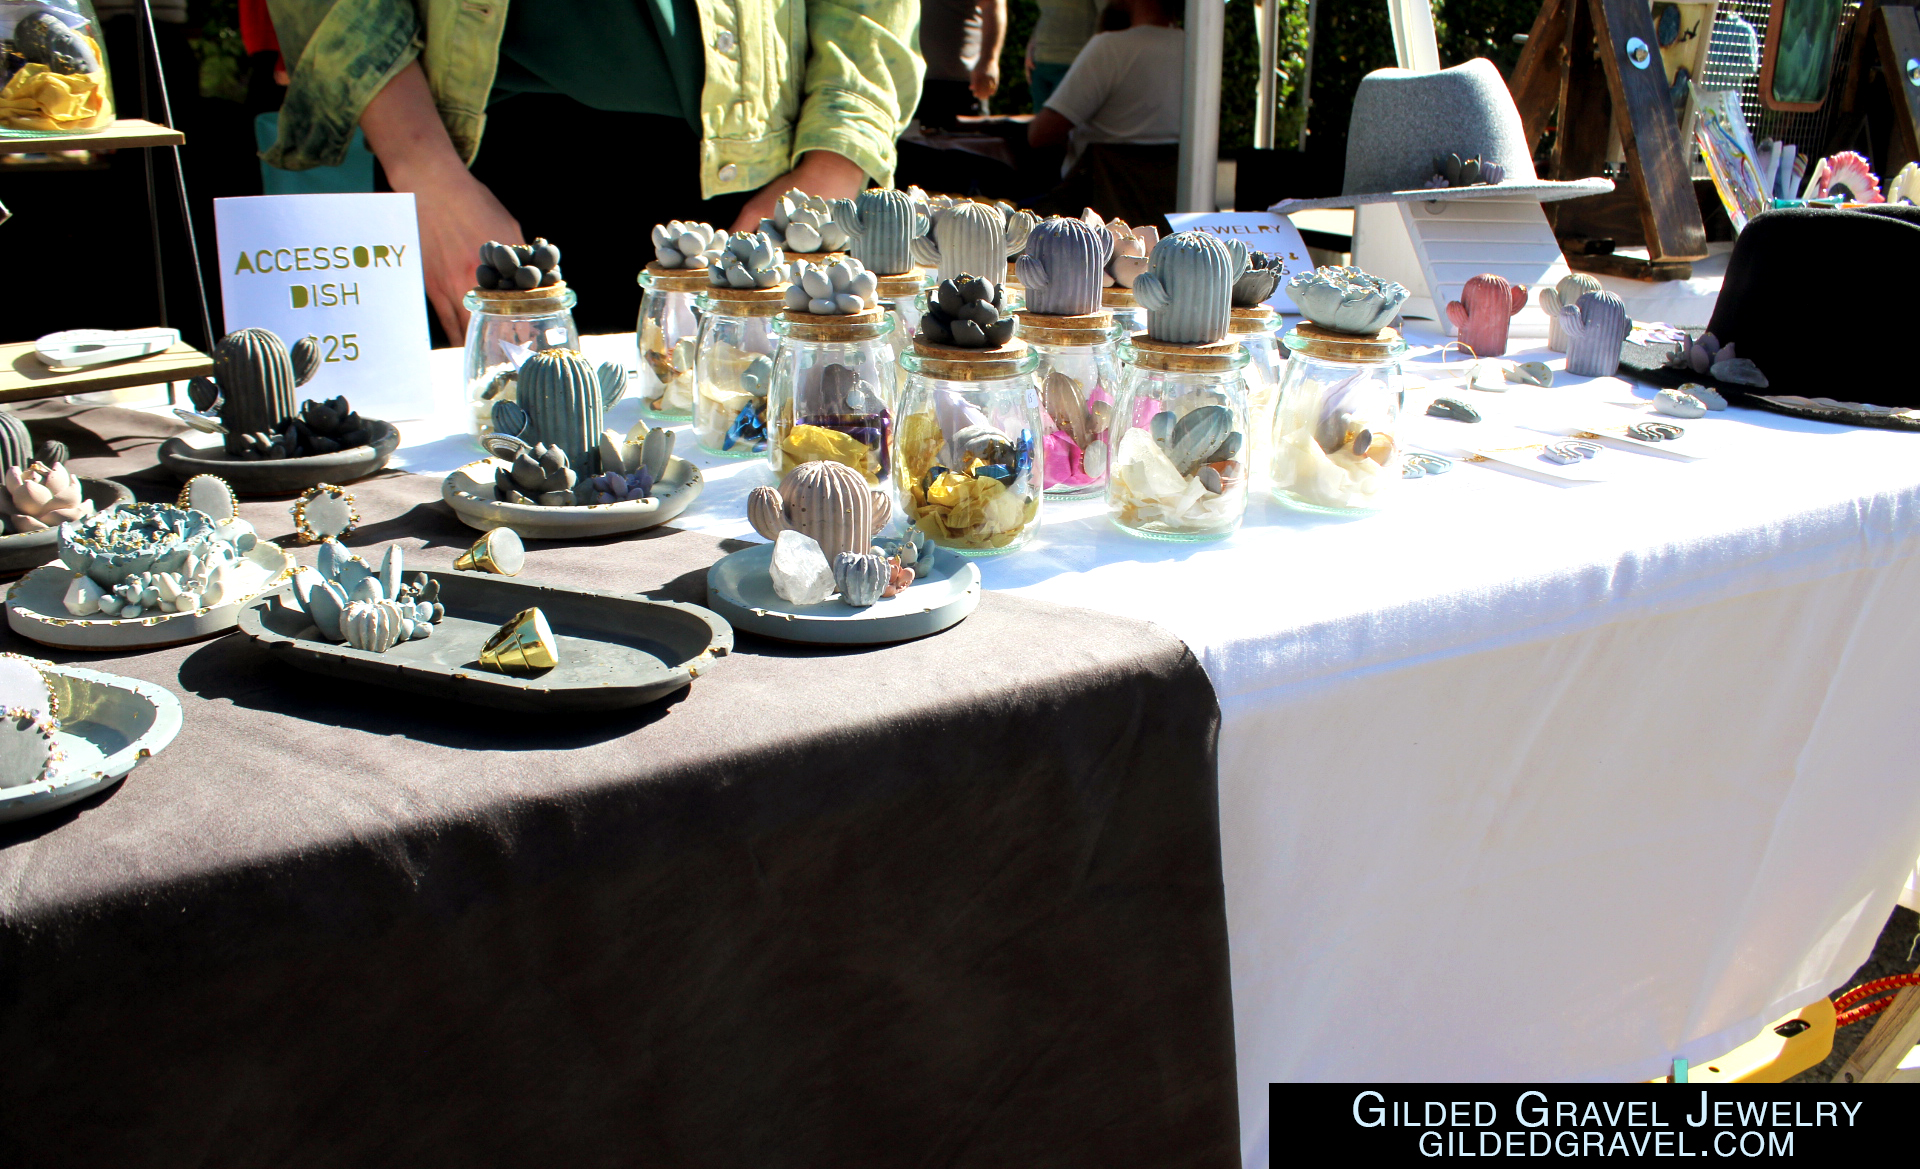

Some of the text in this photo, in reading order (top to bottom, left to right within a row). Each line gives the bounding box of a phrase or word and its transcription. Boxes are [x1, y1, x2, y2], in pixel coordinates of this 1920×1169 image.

[235, 245, 406, 275] ACCESSORY
[290, 282, 360, 309] DISH
[309, 333, 360, 363] 25
